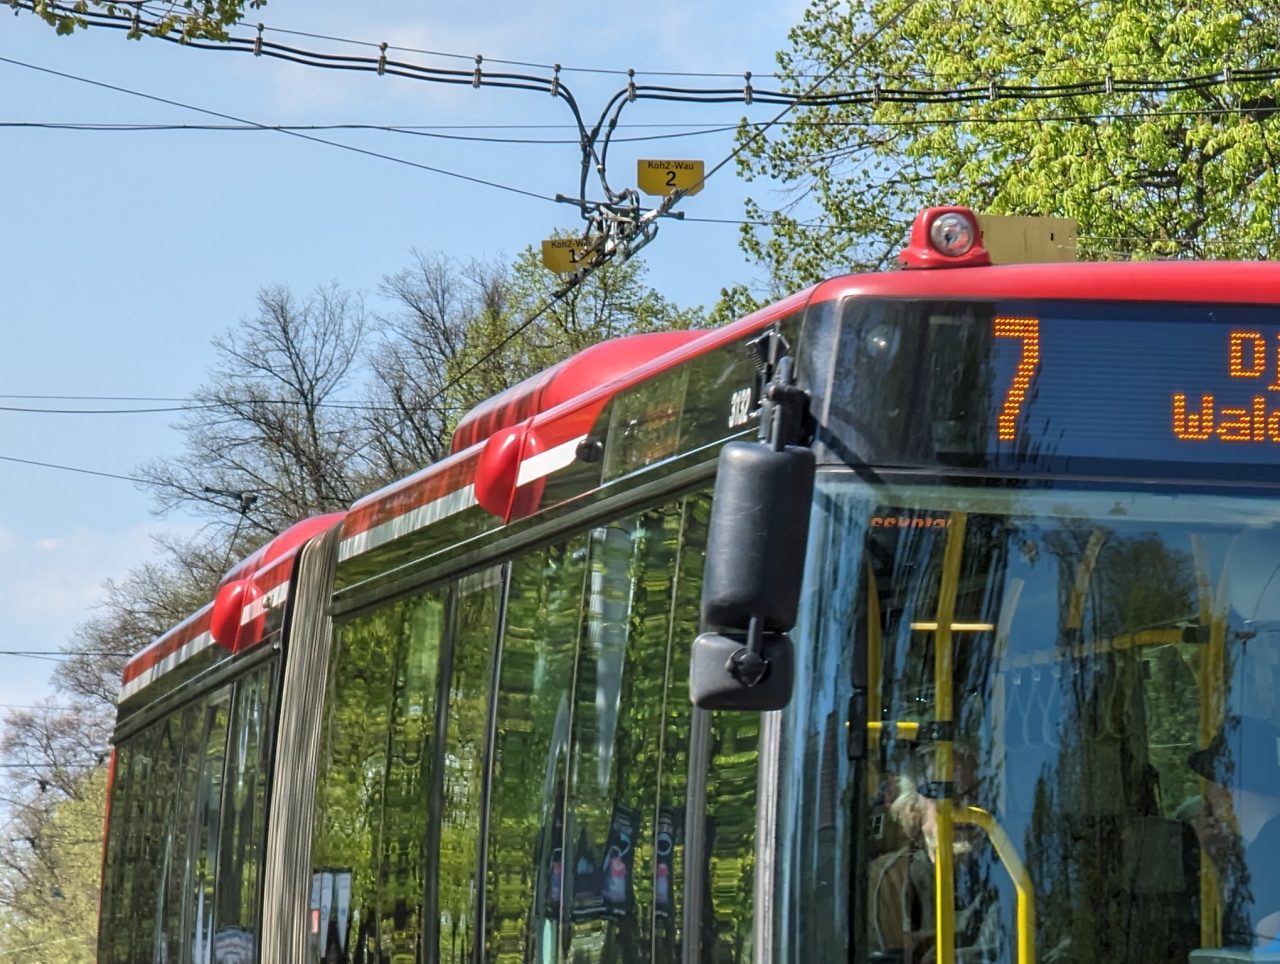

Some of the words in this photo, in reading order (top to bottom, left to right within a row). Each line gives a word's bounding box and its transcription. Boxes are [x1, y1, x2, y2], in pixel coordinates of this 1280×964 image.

[647, 161, 694, 170] Koh2-Wau
[665, 171, 676, 187] 2
[569, 249, 578, 263] 1
[994, 317, 1039, 440] 7
